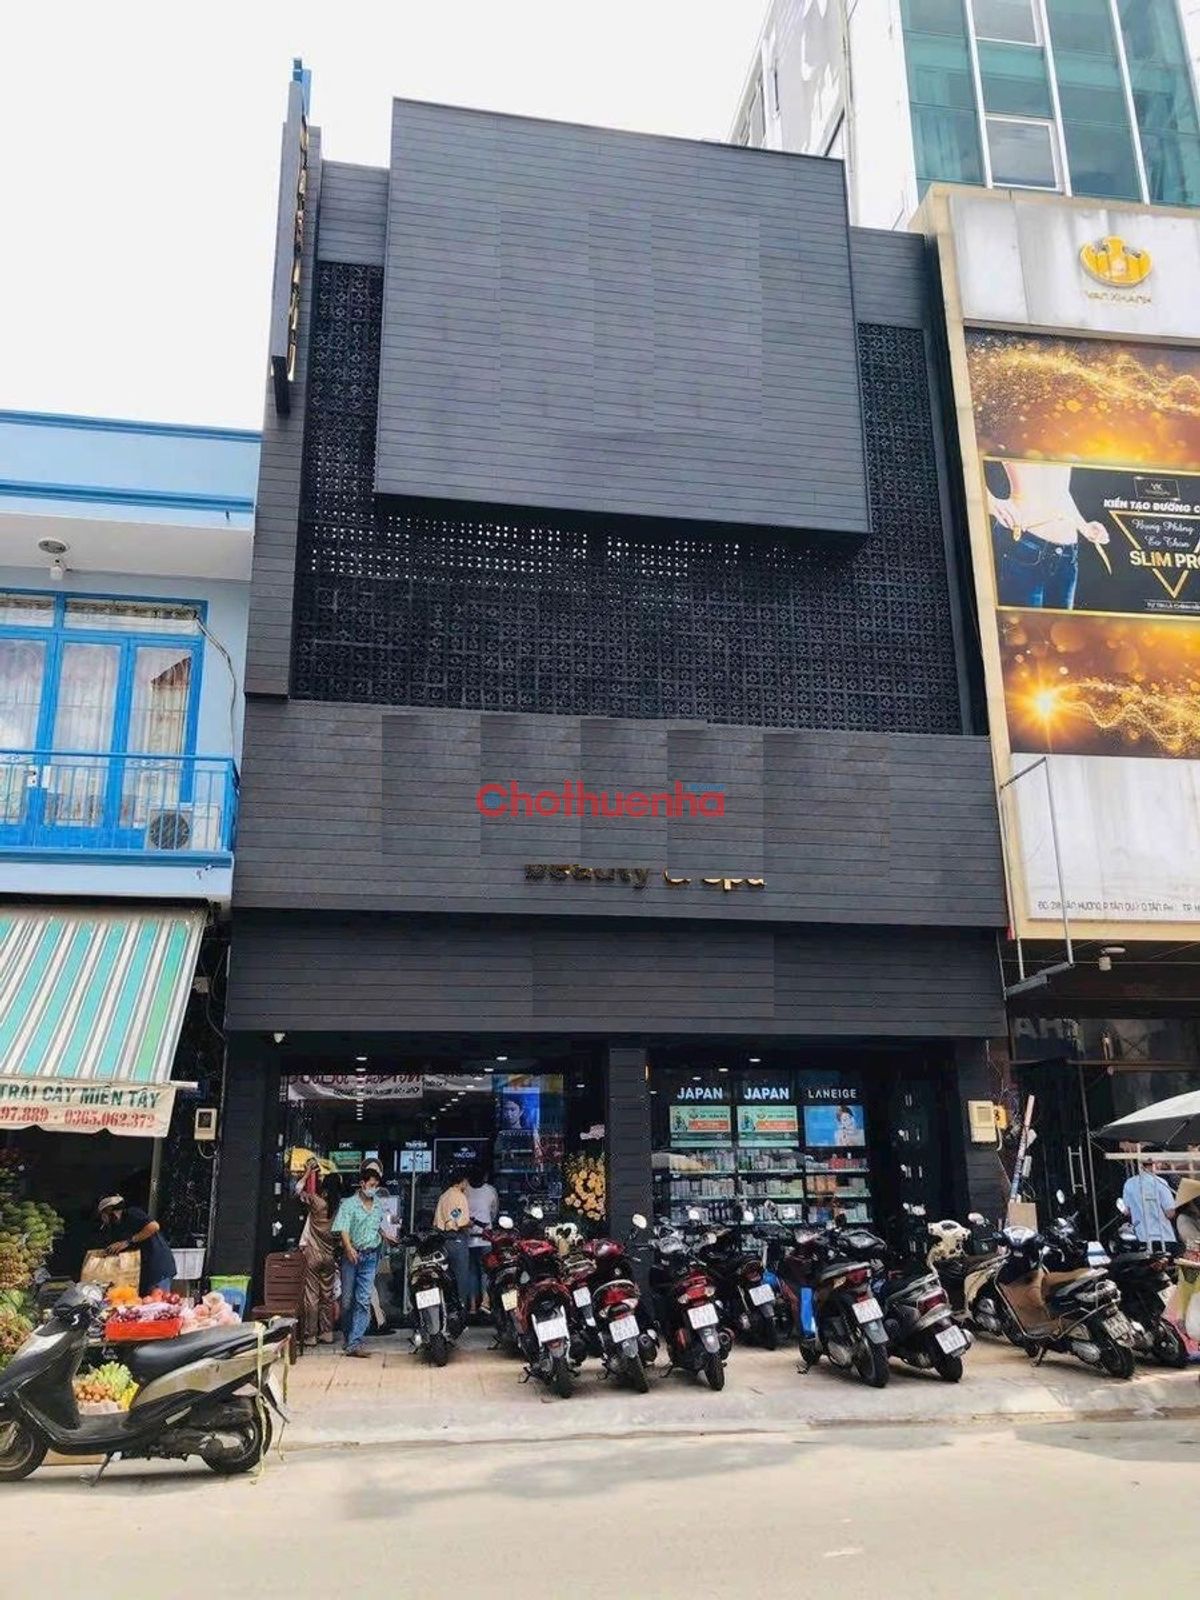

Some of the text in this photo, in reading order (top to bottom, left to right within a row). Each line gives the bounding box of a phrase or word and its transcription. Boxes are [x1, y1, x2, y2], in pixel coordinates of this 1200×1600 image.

[1130, 550, 1200, 569] SLIM PR
[80, 1085, 124, 1106] MIỀN
[129, 1087, 161, 1108] TÂY
[677, 1087, 724, 1100] JAPAN
[744, 1087, 790, 1100] JAPAN
[808, 1089, 857, 1099] LANEIGE
